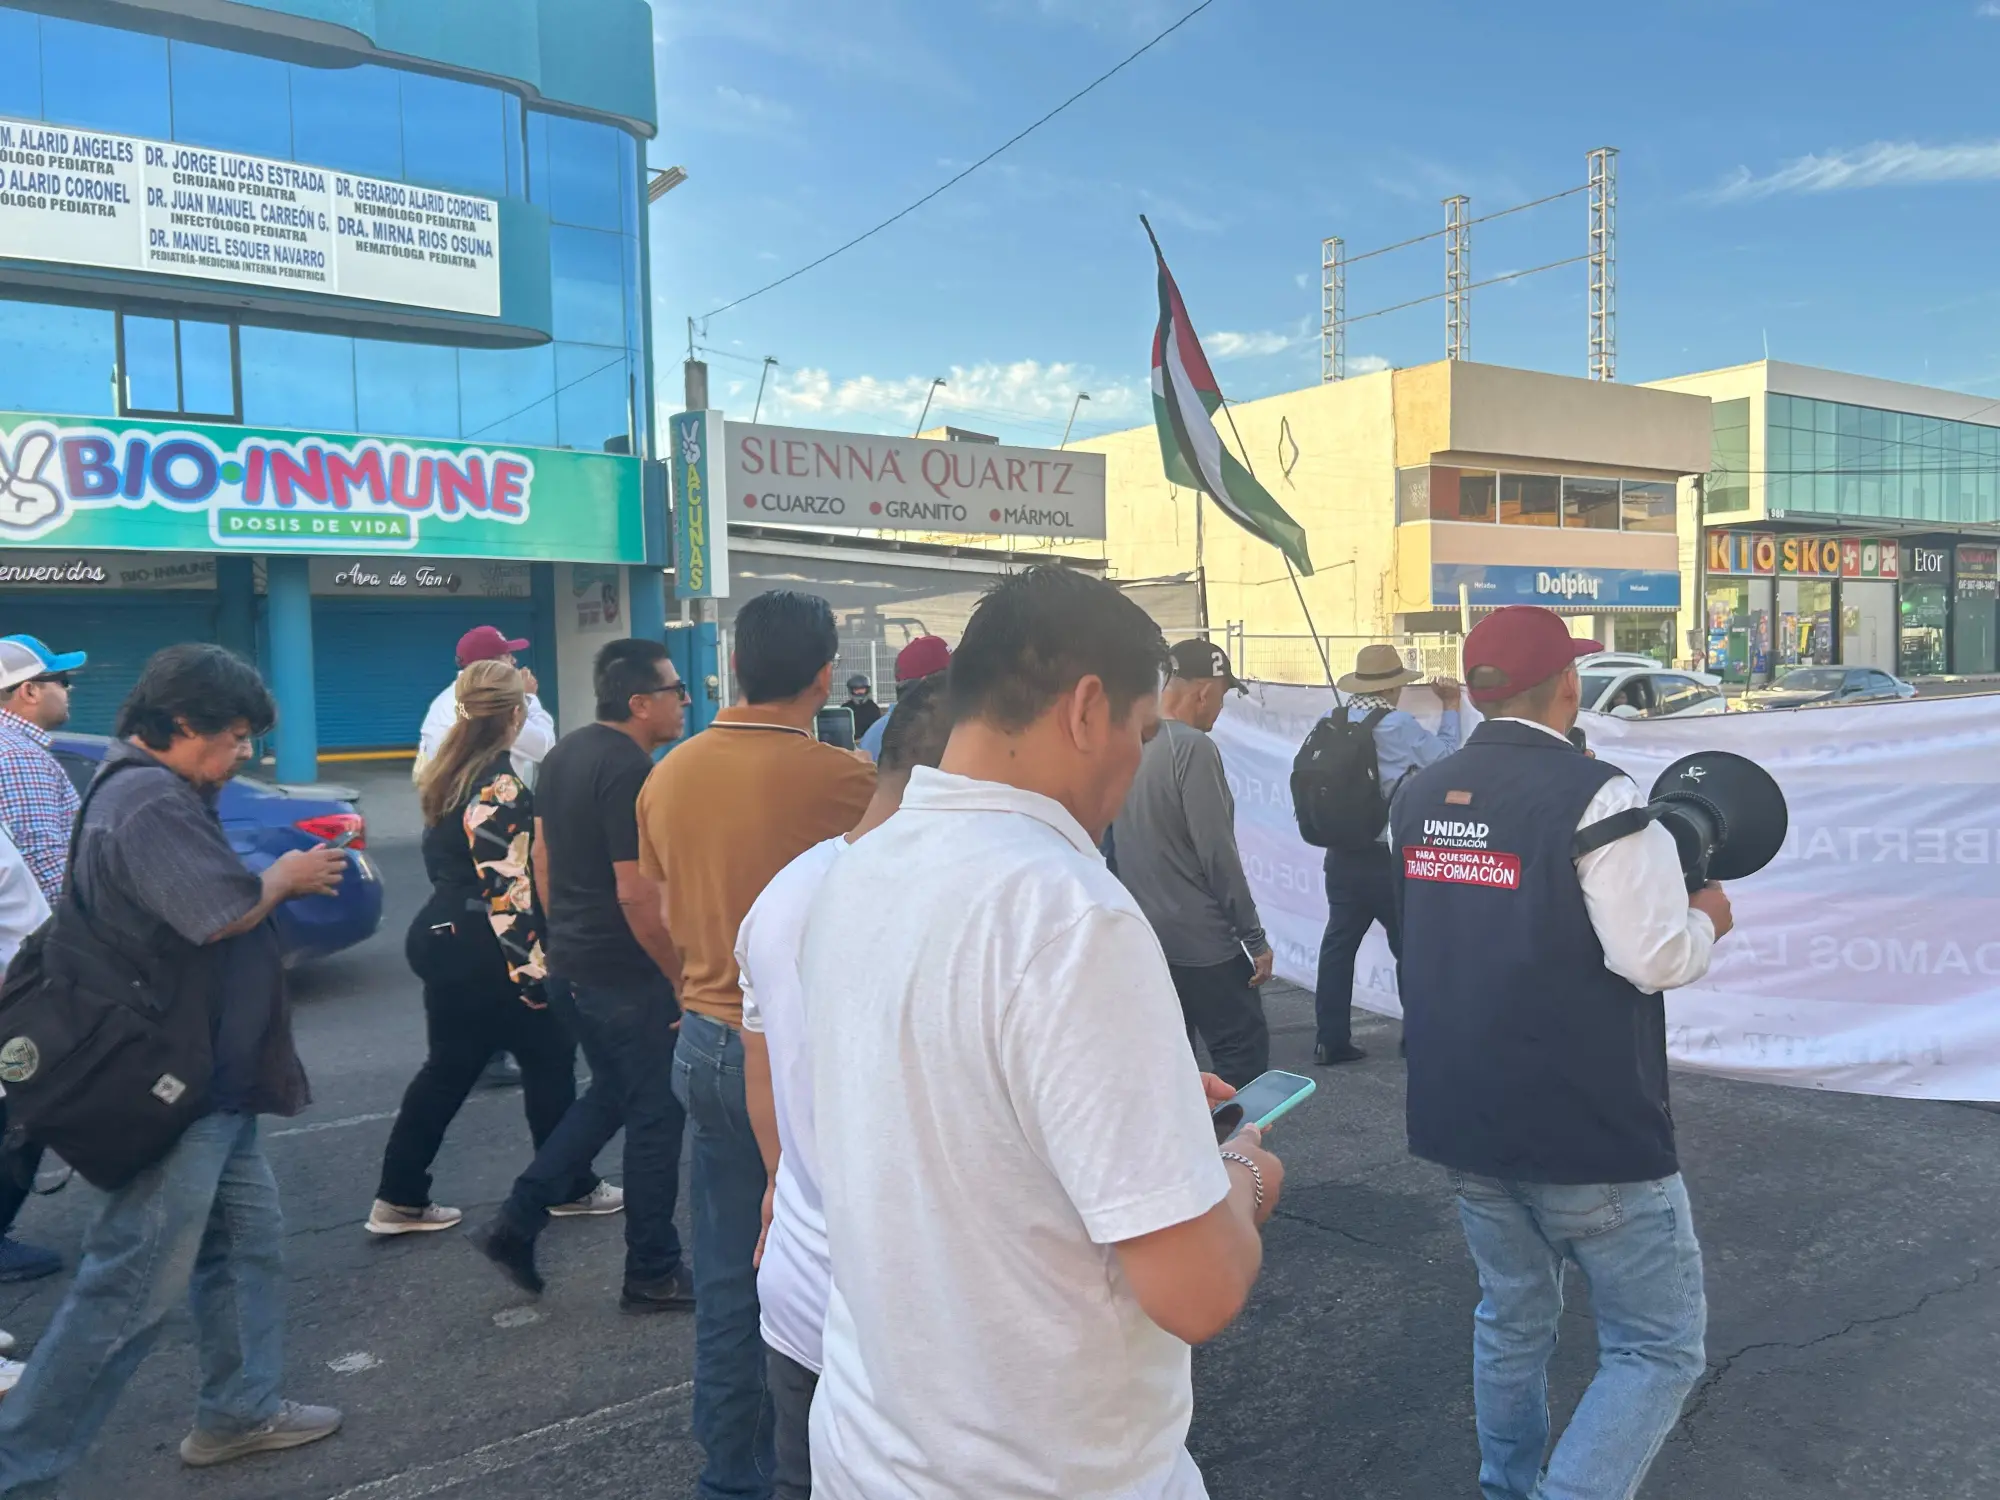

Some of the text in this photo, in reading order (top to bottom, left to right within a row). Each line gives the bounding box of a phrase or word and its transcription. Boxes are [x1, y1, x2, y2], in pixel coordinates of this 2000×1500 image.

[19, 129, 69, 154] ALARID
[72, 136, 133, 163] ANGELES
[48, 155, 115, 175] PEDIATRA
[145, 145, 326, 193] DR. JORGE LUCAS ESTRADA
[10, 170, 60, 195] ALARID
[65, 176, 130, 204] CORONEL
[172, 172, 296, 202] CIRUJANO PEDIATRA
[336, 177, 492, 222] DR. GERARDO ALARID CORONEL
[50, 198, 116, 217] PEDIATRA
[147, 187, 330, 232] DR. JUAN MANUEL CARREÓN G.
[354, 201, 476, 233] NEUMÓLOGO PEDIATRA
[170, 212, 307, 243] INFECTÓLOGO PEDIATRA
[337, 216, 493, 258] DRA. MIRNA RIOS OSUNA
[149, 228, 325, 268] DR. MANUEL ESQUER NAVARRO
[355, 240, 477, 269] HEMATÓLOGA PEDIATRA
[242, 261, 277, 276] INTERNA
[740, 436, 1075, 499] SIENNA QUARTZ
[761, 493, 1074, 527] CUARZO GRANITO MÁRMOL
[230, 516, 401, 534] DOSIS DE VIDA
[1710, 534, 1840, 572] KIOSKO
[1914, 547, 1944, 572] Etor
[389, 570, 407, 586] de
[1536, 571, 1598, 600] Dolphy
[1211, 651, 1224, 677] 2
[1422, 836, 1428, 845] Y
[1423, 819, 1490, 839] UNIDAD
[1407, 860, 1515, 885] TRANSFORMACIÓN
[1415, 850, 1436, 861] PARA
[1482, 855, 1495, 866] LA
